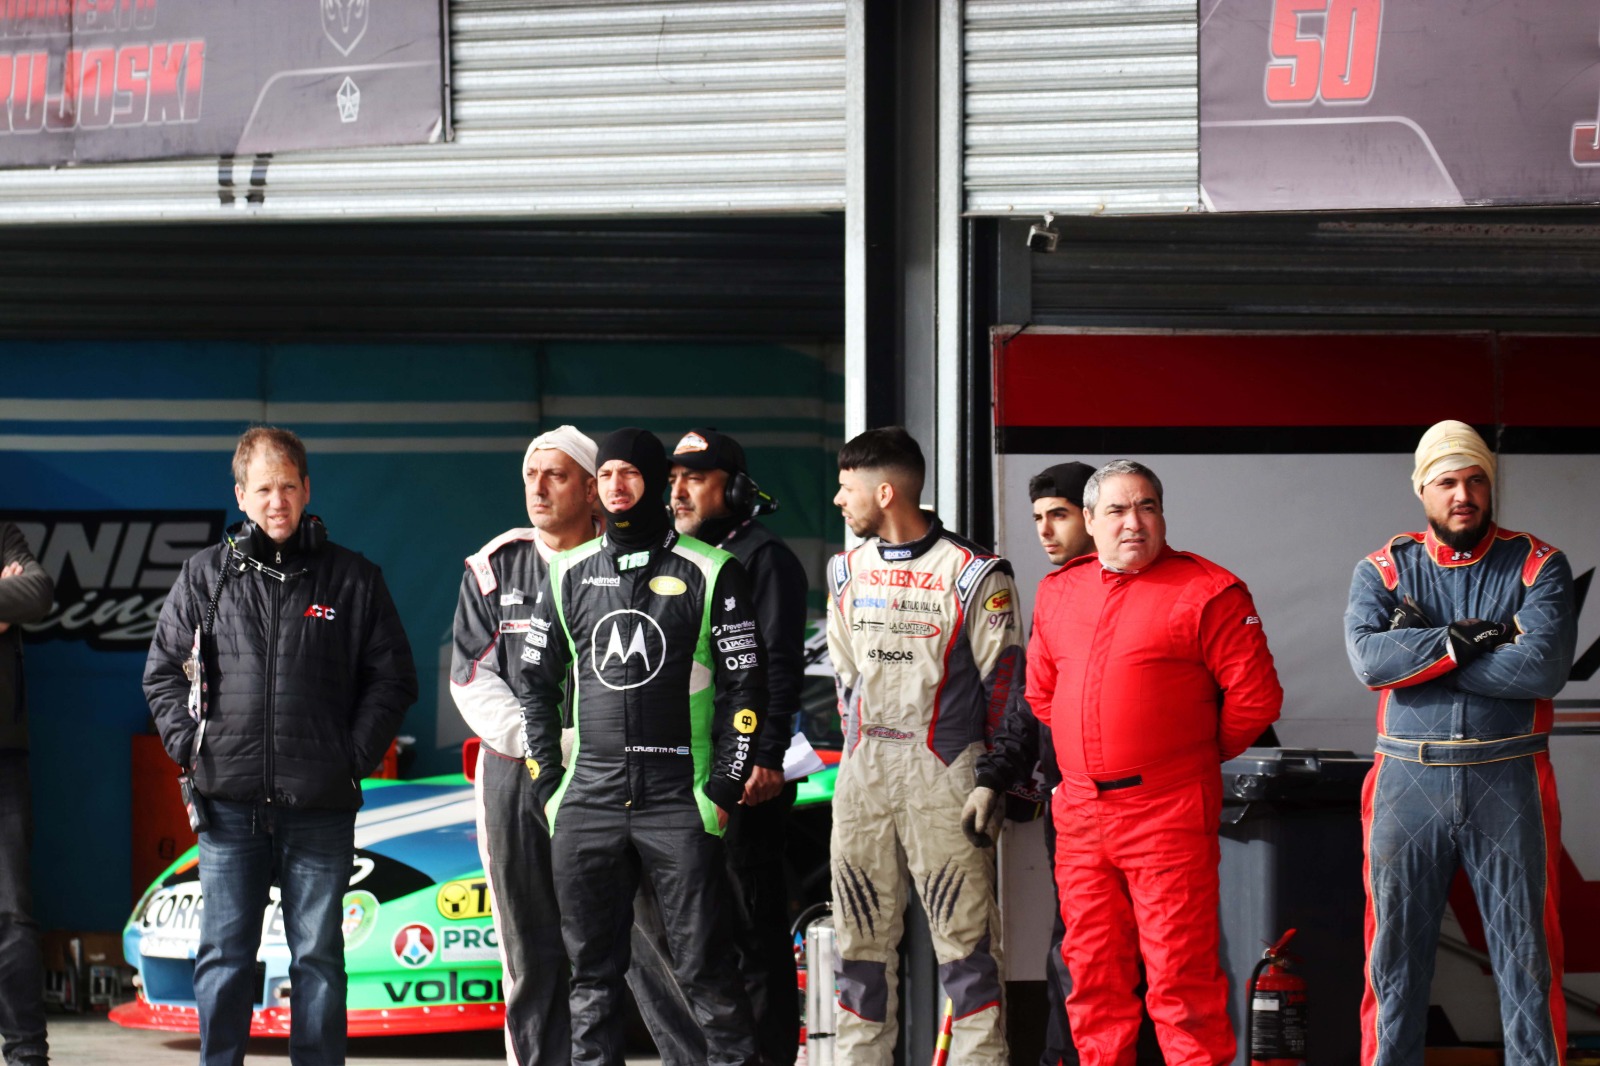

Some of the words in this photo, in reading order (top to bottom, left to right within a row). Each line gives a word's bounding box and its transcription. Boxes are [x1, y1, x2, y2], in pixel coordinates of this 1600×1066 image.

[1265, 0, 1384, 107] 50
[617, 551, 650, 571] 115
[869, 569, 945, 591] SCIENZA
[738, 652, 757, 665] SGB
